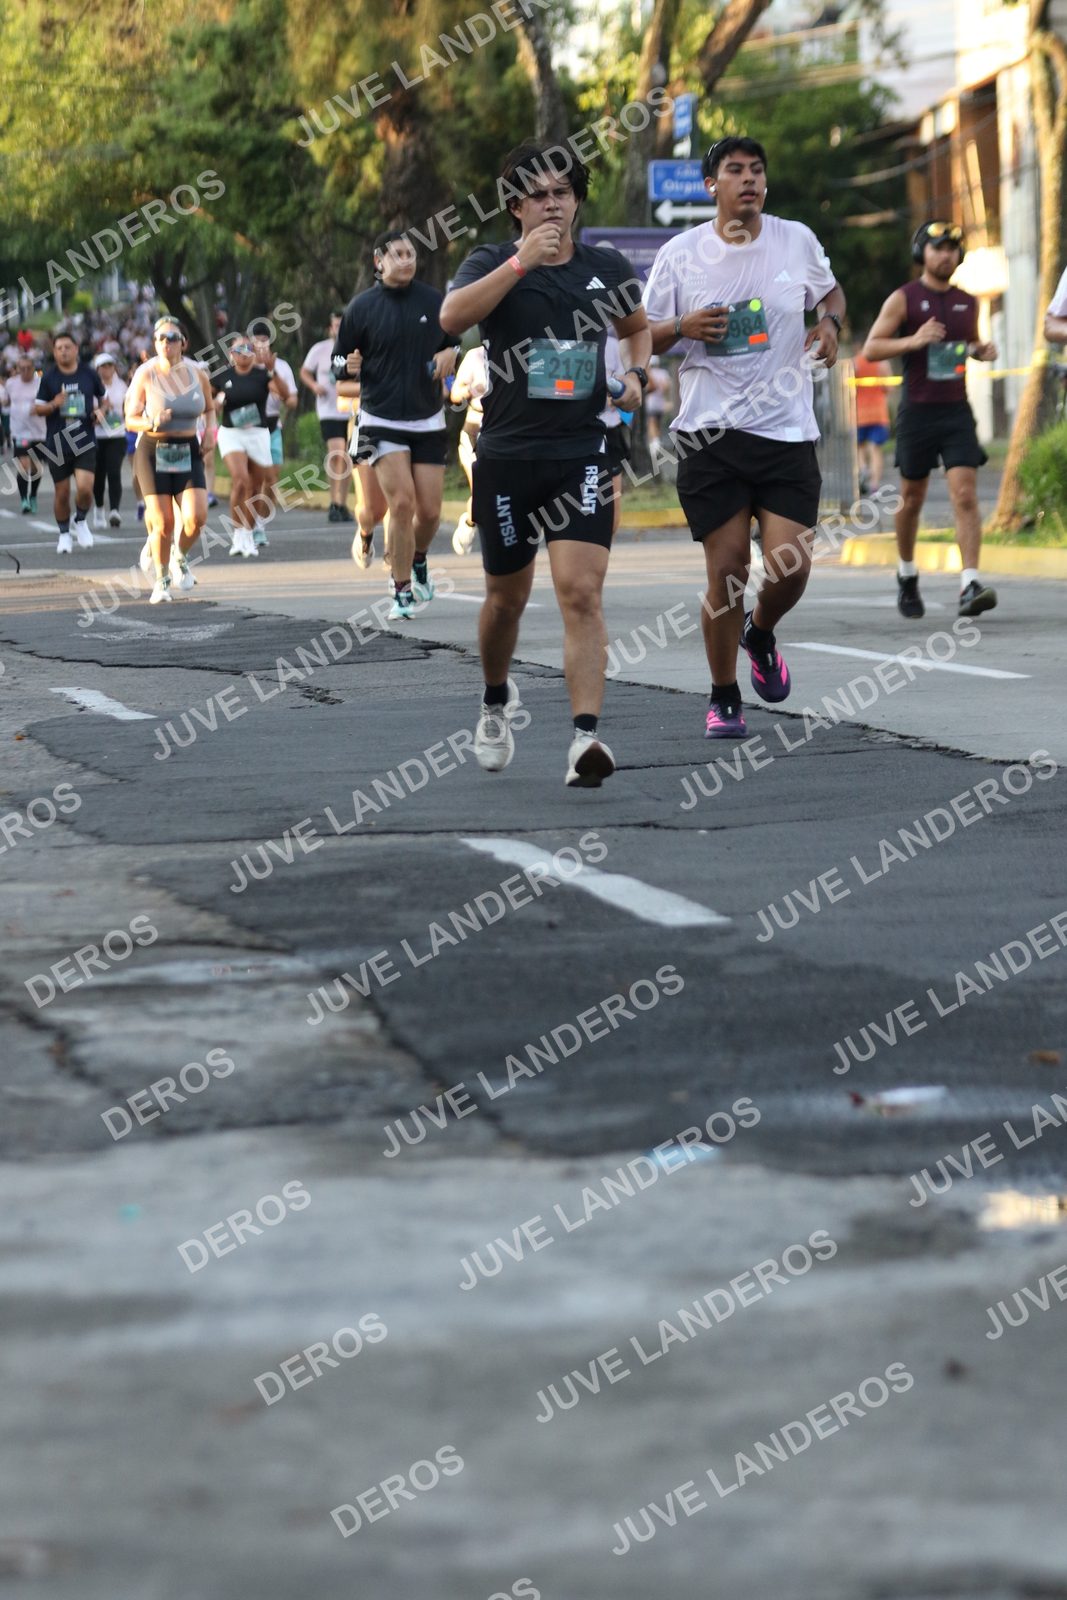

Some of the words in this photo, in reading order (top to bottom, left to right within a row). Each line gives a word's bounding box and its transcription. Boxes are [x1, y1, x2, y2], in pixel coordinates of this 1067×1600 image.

[723, 314, 762, 339] 984
[549, 356, 594, 381] 2179
[581, 465, 598, 514] RSLNT
[496, 494, 518, 547] RSLNT
